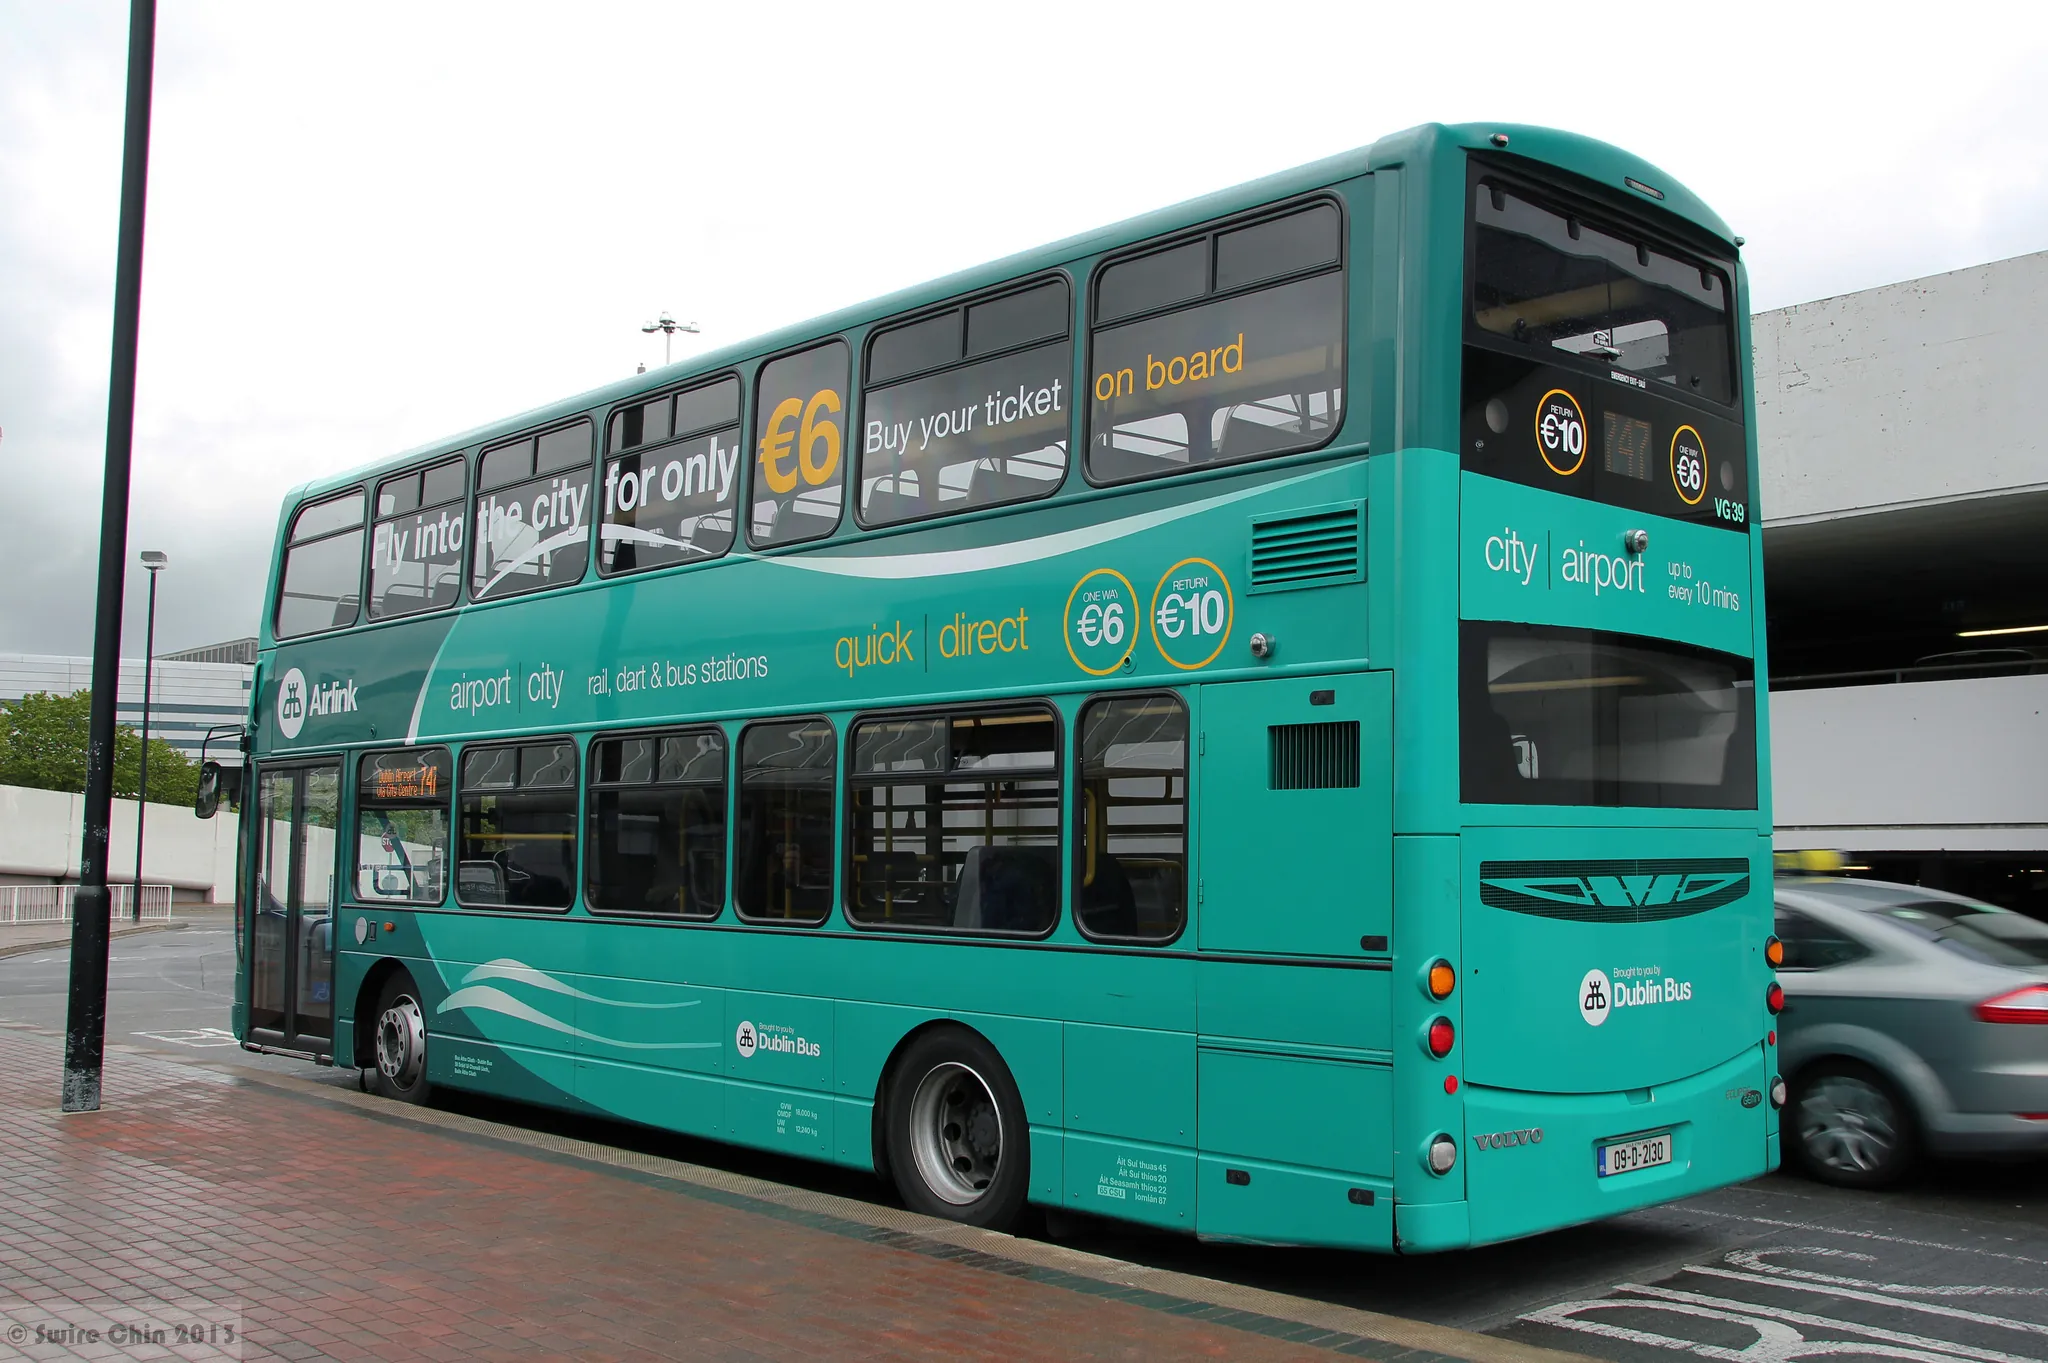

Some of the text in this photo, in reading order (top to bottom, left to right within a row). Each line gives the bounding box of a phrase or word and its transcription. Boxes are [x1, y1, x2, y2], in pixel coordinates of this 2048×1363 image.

[1095, 333, 1244, 401] on board
[865, 378, 1061, 454] Buy your ticket
[1551, 404, 1573, 418] RETURN
[758, 389, 841, 494] €6
[1540, 413, 1583, 455] €10
[1679, 445, 1689, 455] ONE
[1677, 455, 1700, 491] €6
[371, 436, 739, 575] Fly into the city for only
[1485, 527, 1645, 596] city airport
[1668, 561, 1692, 580] up to
[1083, 591, 1101, 603] ONE
[1172, 577, 1208, 592] RETURN
[1668, 580, 1740, 611] every 10 mins
[1077, 602, 1125, 647] €6
[1156, 590, 1225, 639] €10
[835, 607, 1029, 678] quick direct
[309, 679, 358, 717] Airlink
[450, 652, 768, 716] airport city rail, dart & bus stations
[1613, 965, 1661, 979] Brought to you by
[1614, 977, 1692, 1008] Dublin Bus
[758, 1022, 776, 1033] Brought
[780, 1026, 789, 1034] you
[788, 1026, 795, 1035] by
[758, 1032, 821, 1057] Dublin Bus
[1473, 1127, 1544, 1151] VOLVO
[1116, 1155, 1126, 1166] Áit
[1139, 1161, 1158, 1171] thuas
[1157, 1164, 1167, 1172] 45
[1614, 1141, 1664, 1171] 09-D-2130
[1099, 1174, 1109, 1184] Áit
[1109, 1177, 1140, 1190] Seasamh
[1158, 1186, 1167, 1194] 22
[1118, 1166, 1128, 1177] Áit
[1157, 1174, 1168, 1184] 20
[1158, 1197, 1167, 1205] 87
